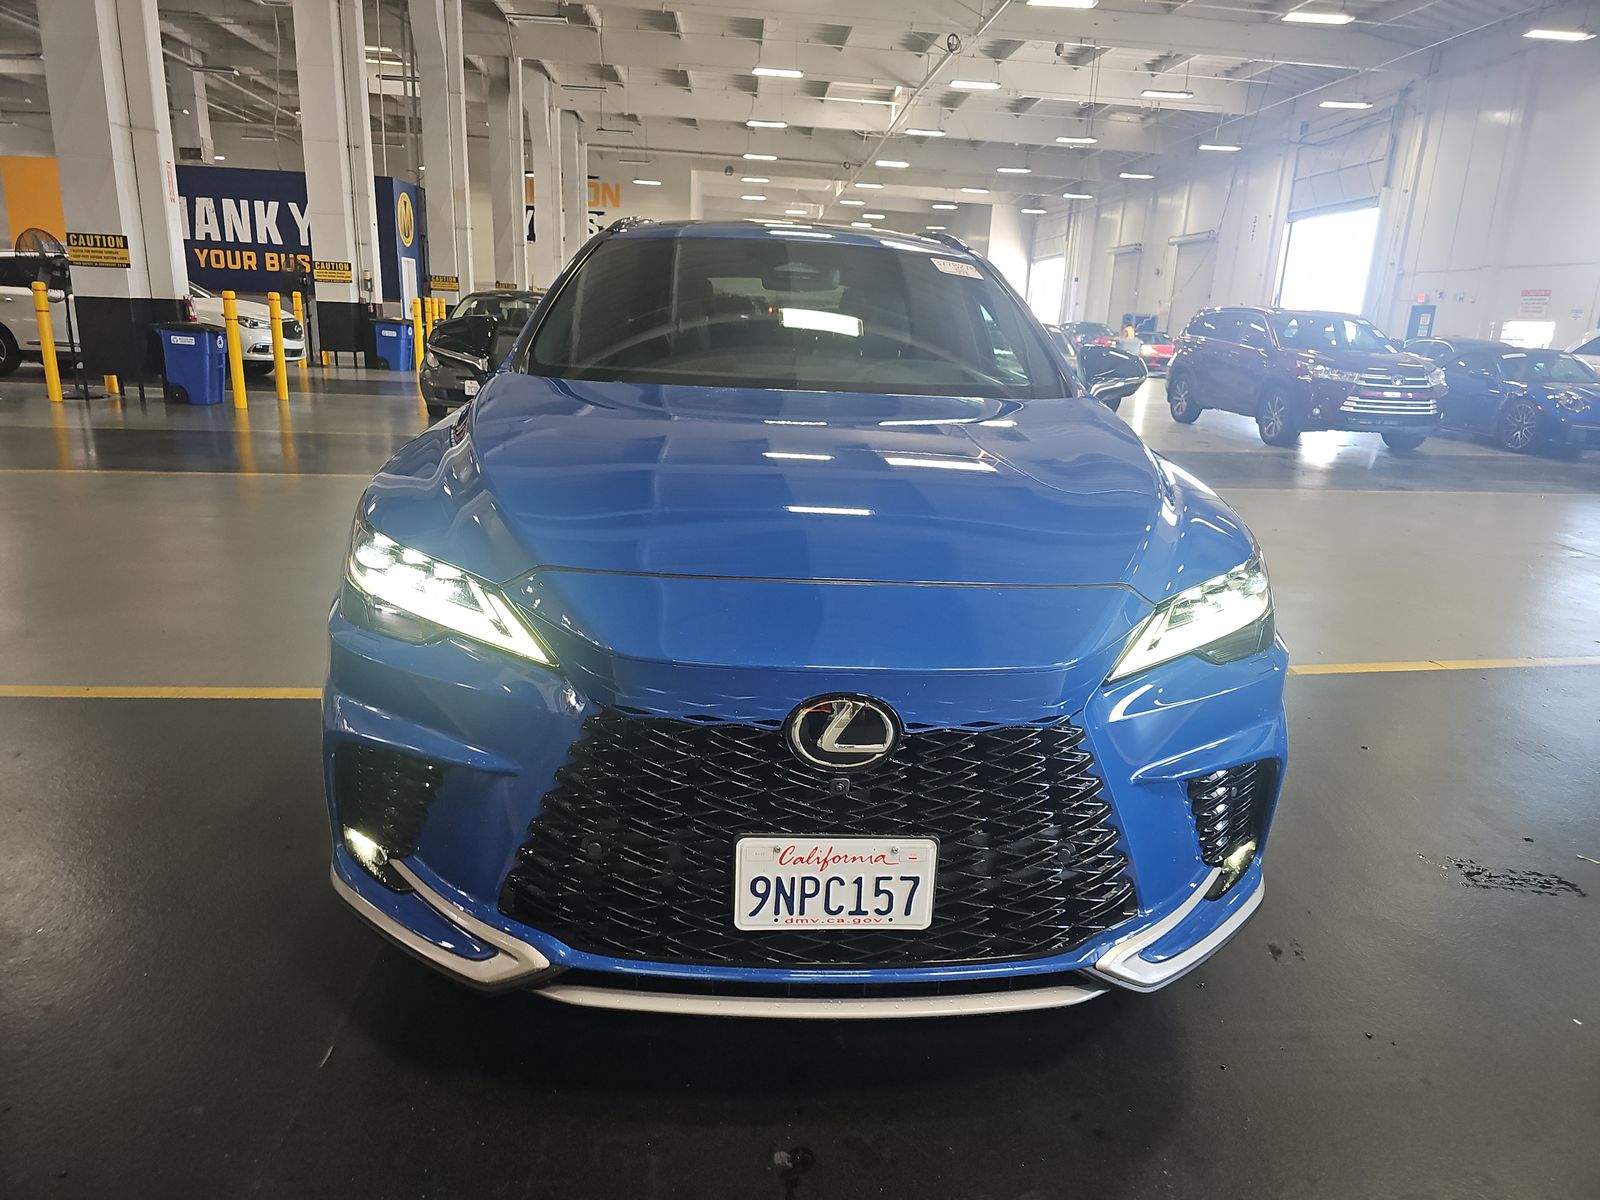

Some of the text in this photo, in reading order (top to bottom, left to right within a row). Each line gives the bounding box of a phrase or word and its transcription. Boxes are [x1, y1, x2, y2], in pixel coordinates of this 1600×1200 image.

[69, 234, 124, 248] CAUTION
[194, 248, 257, 271] YOUR
[315, 262, 349, 271] CAUTION
[431, 275, 457, 283] CAUTION
[778, 845, 899, 872] California
[749, 876, 921, 917] 9NPC157
[784, 916, 883, 925] dmv.ca.gov
